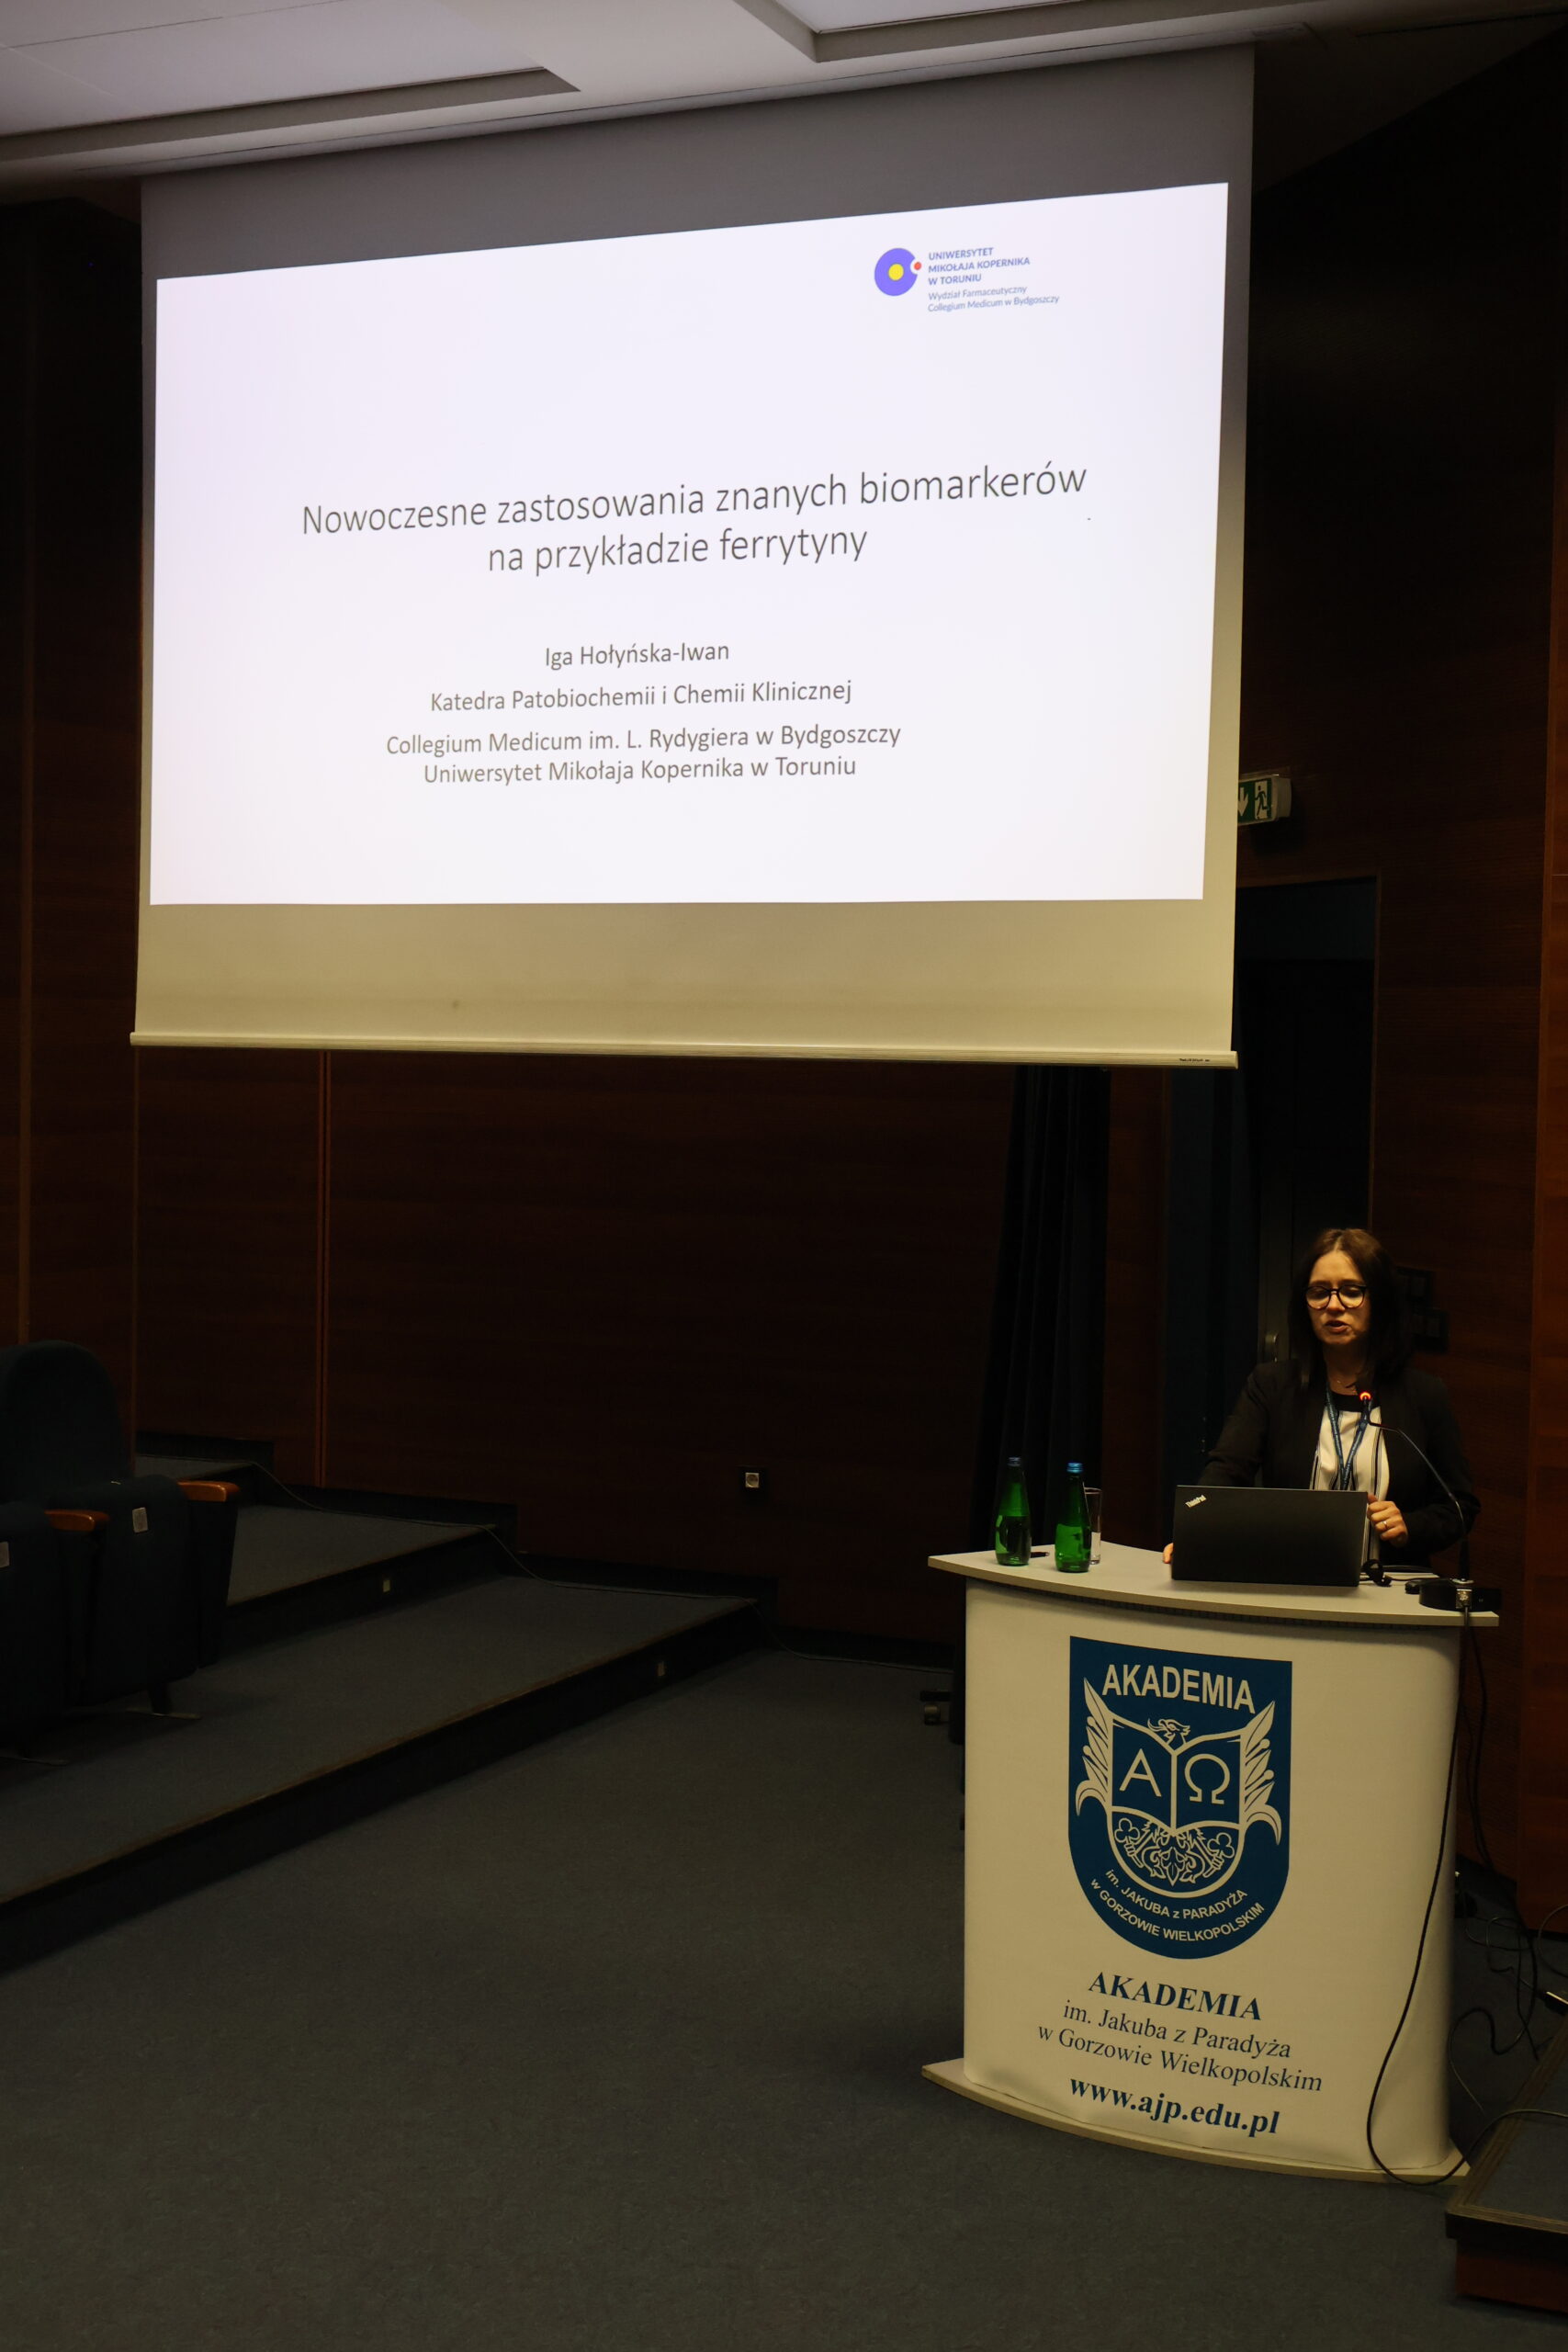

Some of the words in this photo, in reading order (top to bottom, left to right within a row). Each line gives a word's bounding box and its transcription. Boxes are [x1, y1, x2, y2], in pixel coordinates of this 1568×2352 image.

[929, 247, 994, 260] UNIWERSYTET
[929, 262, 975, 273] MIKOŁAJA
[977, 257, 1031, 269] KOPERNIKA
[929, 291, 961, 301] Wydział
[963, 286, 1028, 298] Farmaceutyczny
[941, 274, 982, 285] TORUNIU
[928, 301, 965, 312] Collegium
[967, 297, 1003, 309] Medicum
[1013, 295, 1060, 306] Bydgoszczy
[302, 502, 487, 535] Nowoczesne
[497, 484, 705, 524] zastosowania
[716, 472, 847, 515] znanych
[861, 460, 1088, 504] biomarkerów
[489, 547, 524, 571] na
[536, 532, 709, 577] przykładzie
[719, 527, 868, 565] ferrytyny
[546, 647, 573, 671] Iga
[581, 642, 729, 669] Hołyńska-Iwan
[431, 690, 505, 711] Katedra
[513, 685, 656, 709] Patobiochemii
[661, 685, 667, 705] i
[673, 684, 745, 704] Chemii
[751, 680, 852, 704] Klinicznej
[387, 734, 481, 758] Collegium
[489, 731, 582, 752] Medicum
[589, 730, 620, 750] im.
[626, 729, 642, 749] L.
[649, 727, 749, 752] Rydygiera
[756, 729, 774, 745] w
[781, 724, 901, 749] Bydgoszczy
[424, 763, 542, 786] Uniwersytet
[549, 760, 634, 785] Mikołaja
[641, 757, 744, 783] Kopernika
[750, 761, 769, 776] w
[775, 755, 856, 775] Toruniu
[1102, 1664, 1256, 1714] AKADEMIA
[1090, 1878, 1101, 1891] w
[1100, 1889, 1160, 1938] GORZOWIE
[1162, 1902, 1266, 1942] WIELKOPOLSKIM
[1105, 1869, 1121, 1889] im.
[1121, 1886, 1171, 1917] JAKUBA
[1172, 1910, 1180, 1919] z
[1182, 1888, 1248, 1920] PARADYŻA
[1089, 1971, 1262, 2020] AKADEMIA
[1063, 1999, 1092, 2024] im.
[1097, 2008, 1168, 2041] Jakuba
[1174, 2028, 1188, 2043] z
[1191, 2026, 1292, 2062] Paradyża
[1038, 2026, 1055, 2042] w
[1058, 2028, 1153, 2066] Gorzowie
[1159, 2050, 1324, 2092] Wielkopolskim
[1069, 2077, 1280, 2139] www.ajp.edu.pl
